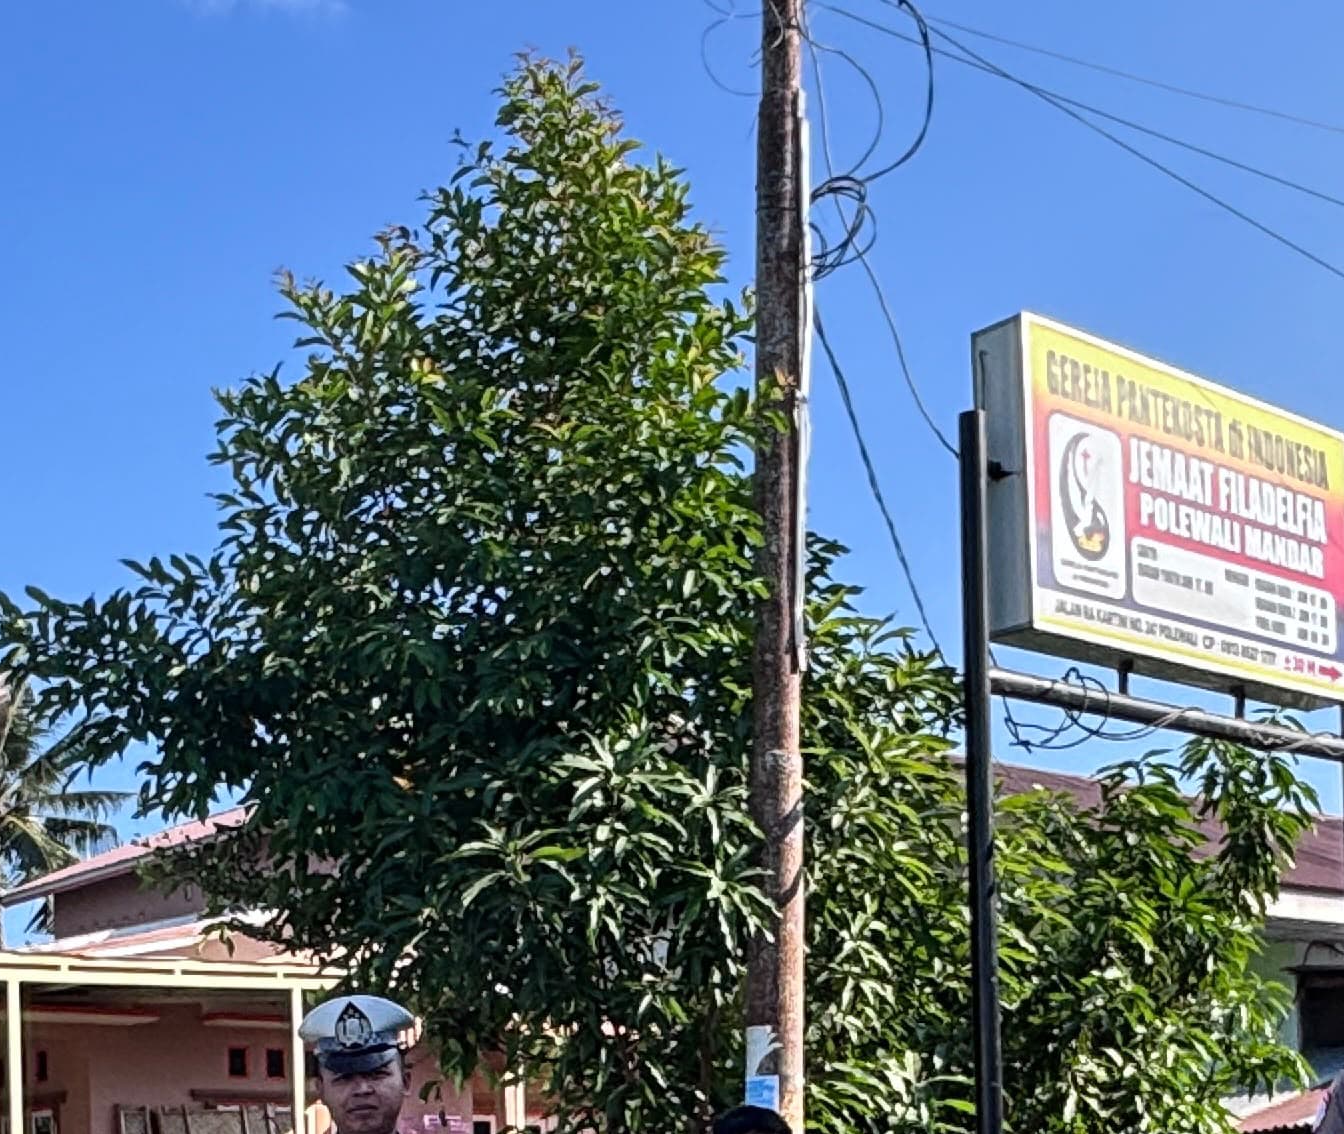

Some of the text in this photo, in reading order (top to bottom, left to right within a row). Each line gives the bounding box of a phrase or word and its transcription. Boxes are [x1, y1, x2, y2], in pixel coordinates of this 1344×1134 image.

[1047, 350, 1111, 413] GEREJA
[1116, 374, 1225, 453] PANTEKOSTA
[1247, 423, 1329, 491] INDONESIA
[1129, 437, 1327, 545] JEMAAT FILADELFIA
[1140, 491, 1241, 554] POLEWALI
[1244, 523, 1324, 579] MANDAR
